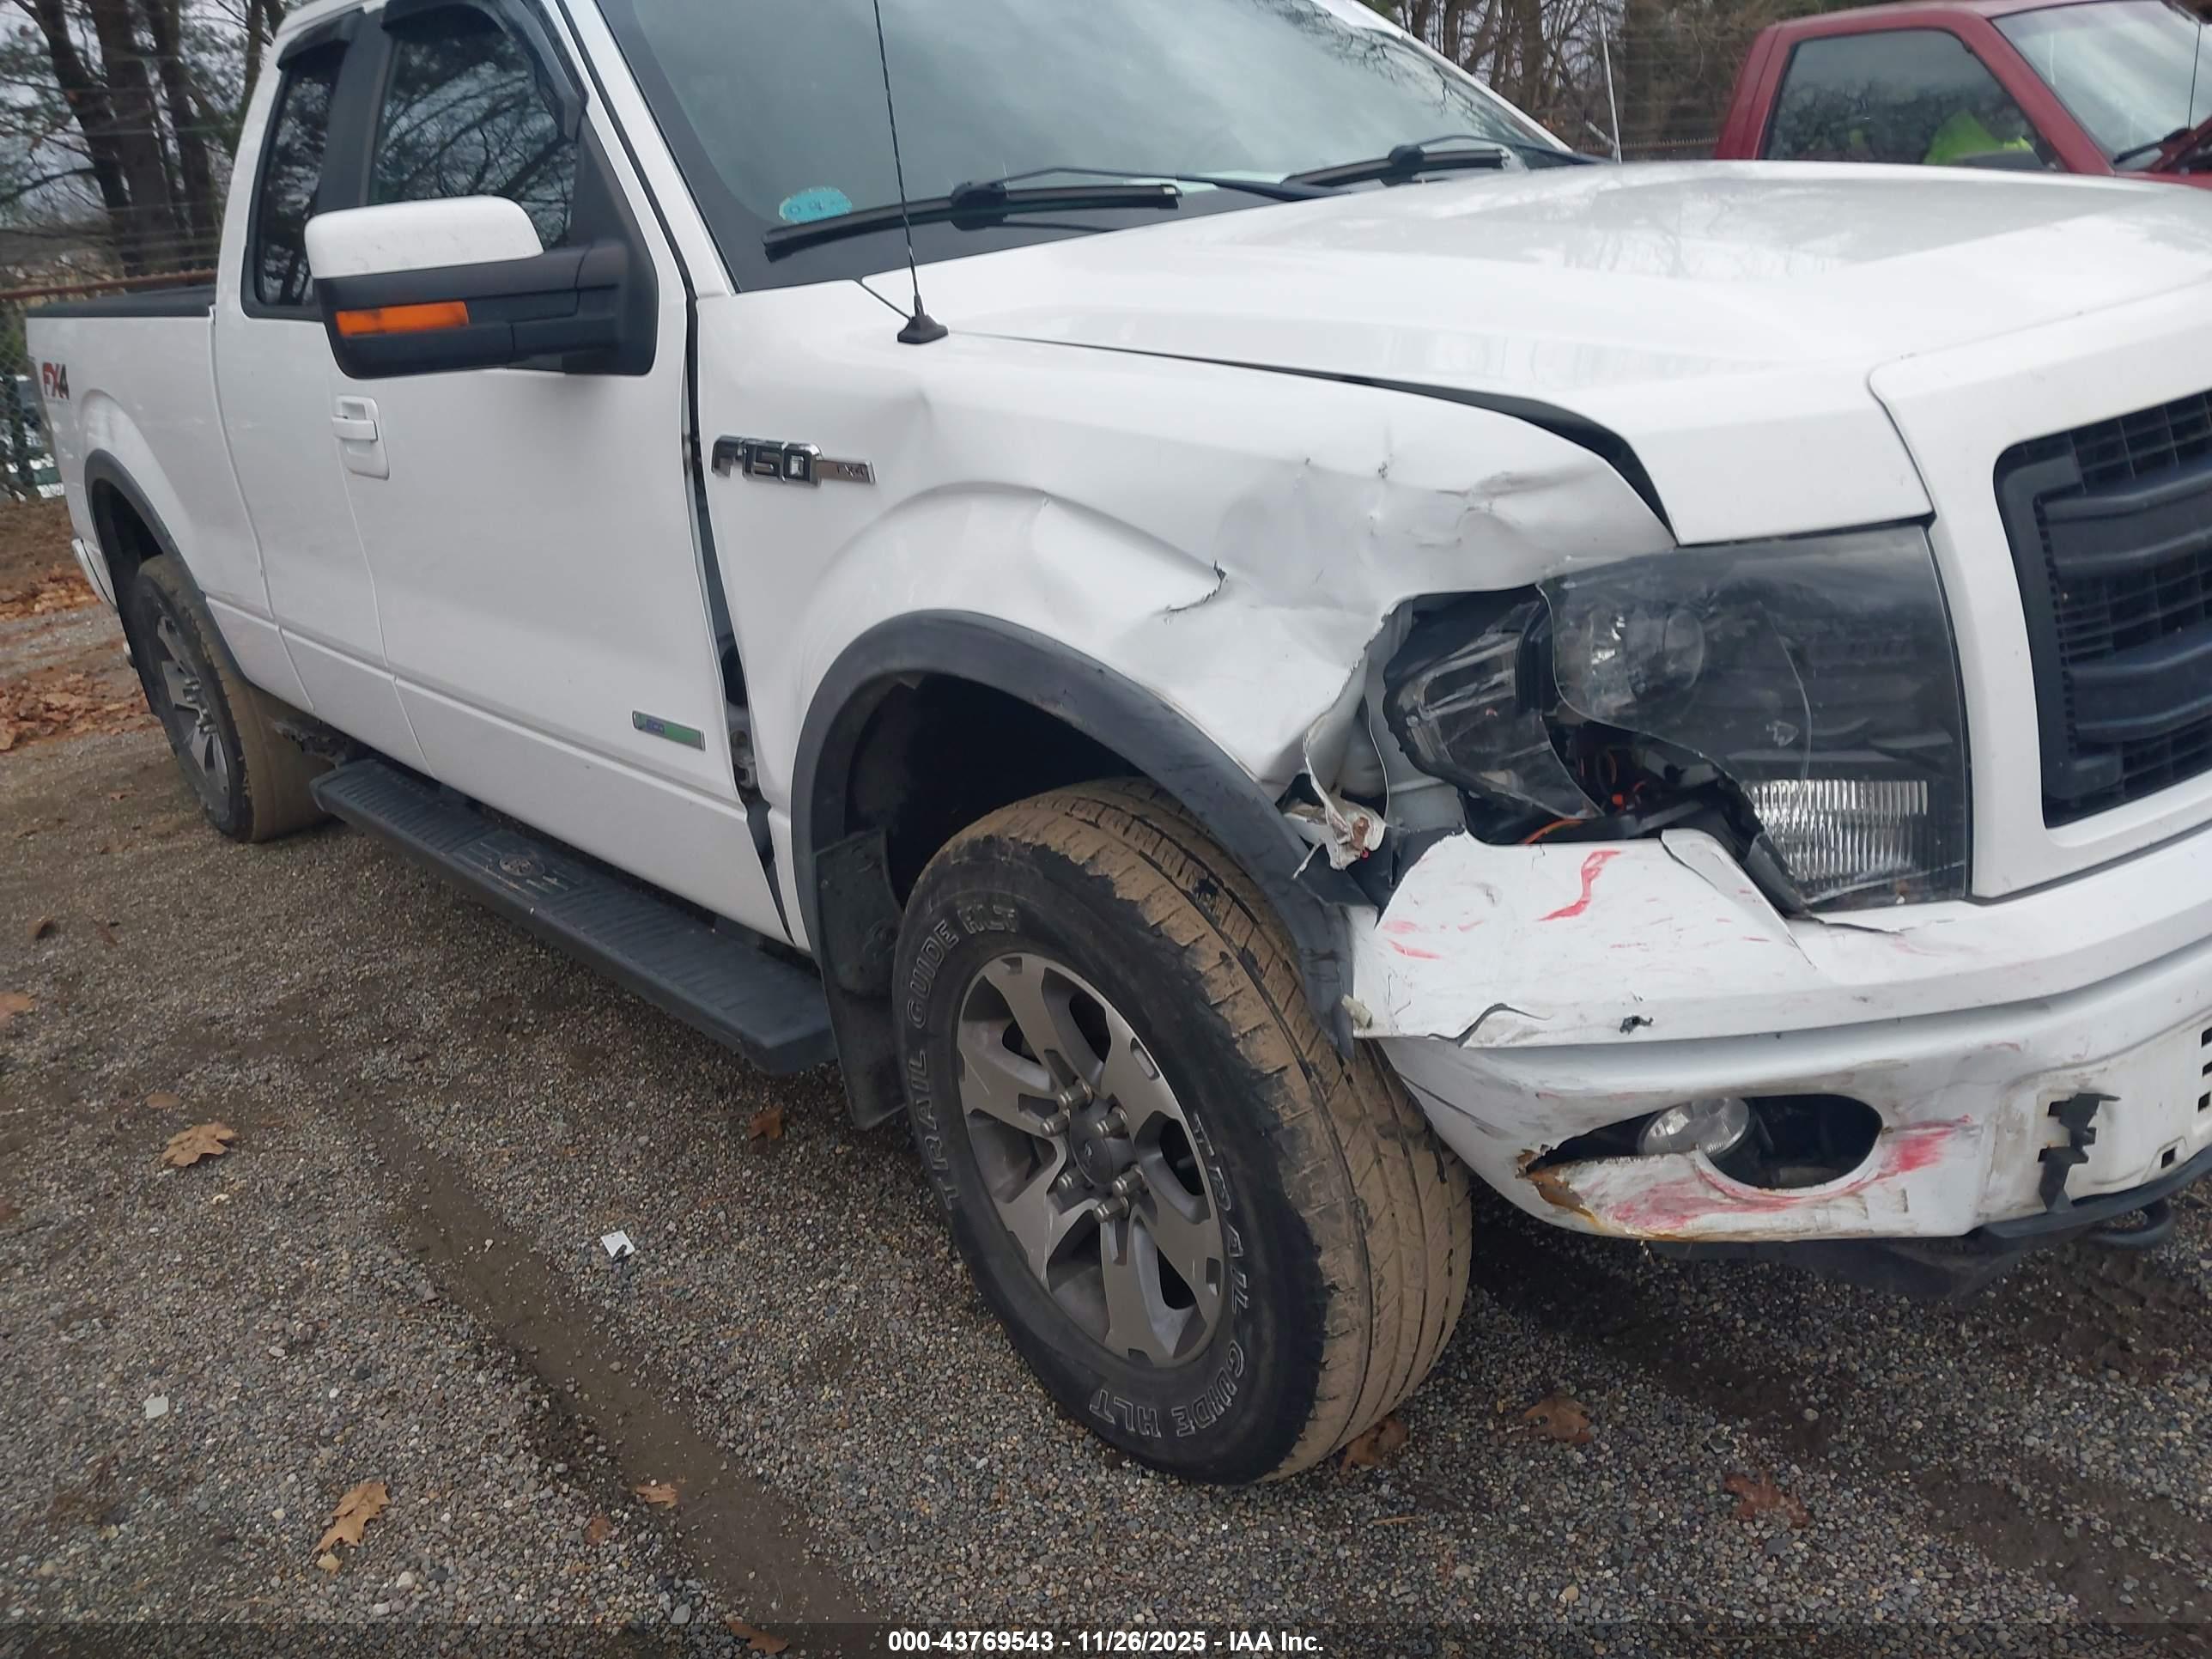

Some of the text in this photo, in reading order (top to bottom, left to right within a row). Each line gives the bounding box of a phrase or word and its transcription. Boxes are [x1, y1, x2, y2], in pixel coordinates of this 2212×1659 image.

[42, 362, 70, 401] FX4
[907, 919, 960, 1030] GUIDE
[907, 1048, 960, 1211] TRAIL
[1088, 1111, 1250, 1438] TRAIL GUIDE HLT
